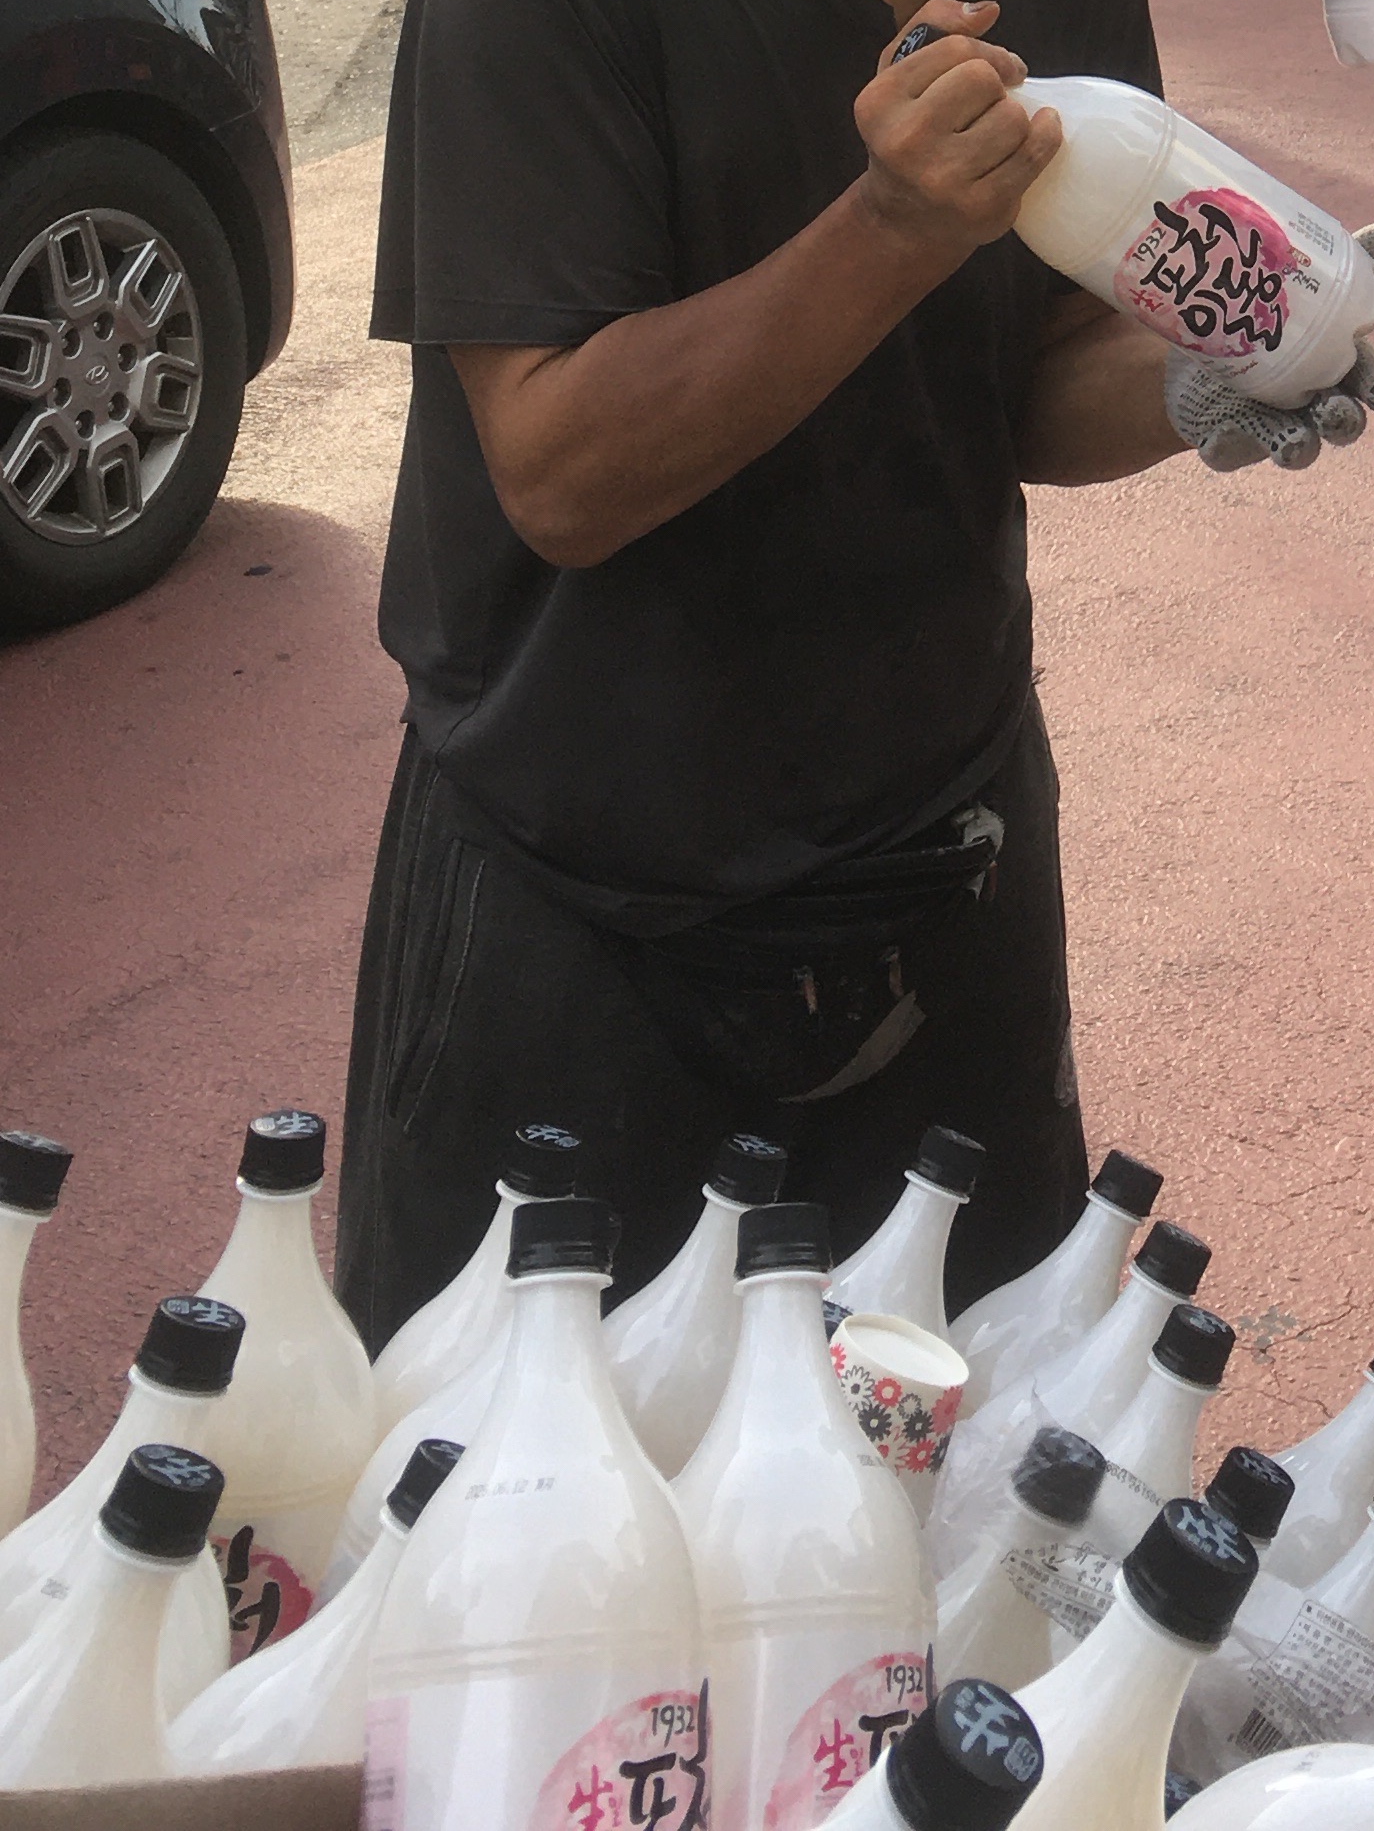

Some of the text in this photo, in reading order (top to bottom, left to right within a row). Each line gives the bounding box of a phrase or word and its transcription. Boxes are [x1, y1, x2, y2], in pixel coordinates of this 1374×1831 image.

[1131, 225, 1167, 262] 1932
[885, 1664, 925, 1703] 1932
[651, 1705, 696, 1748] 1932
